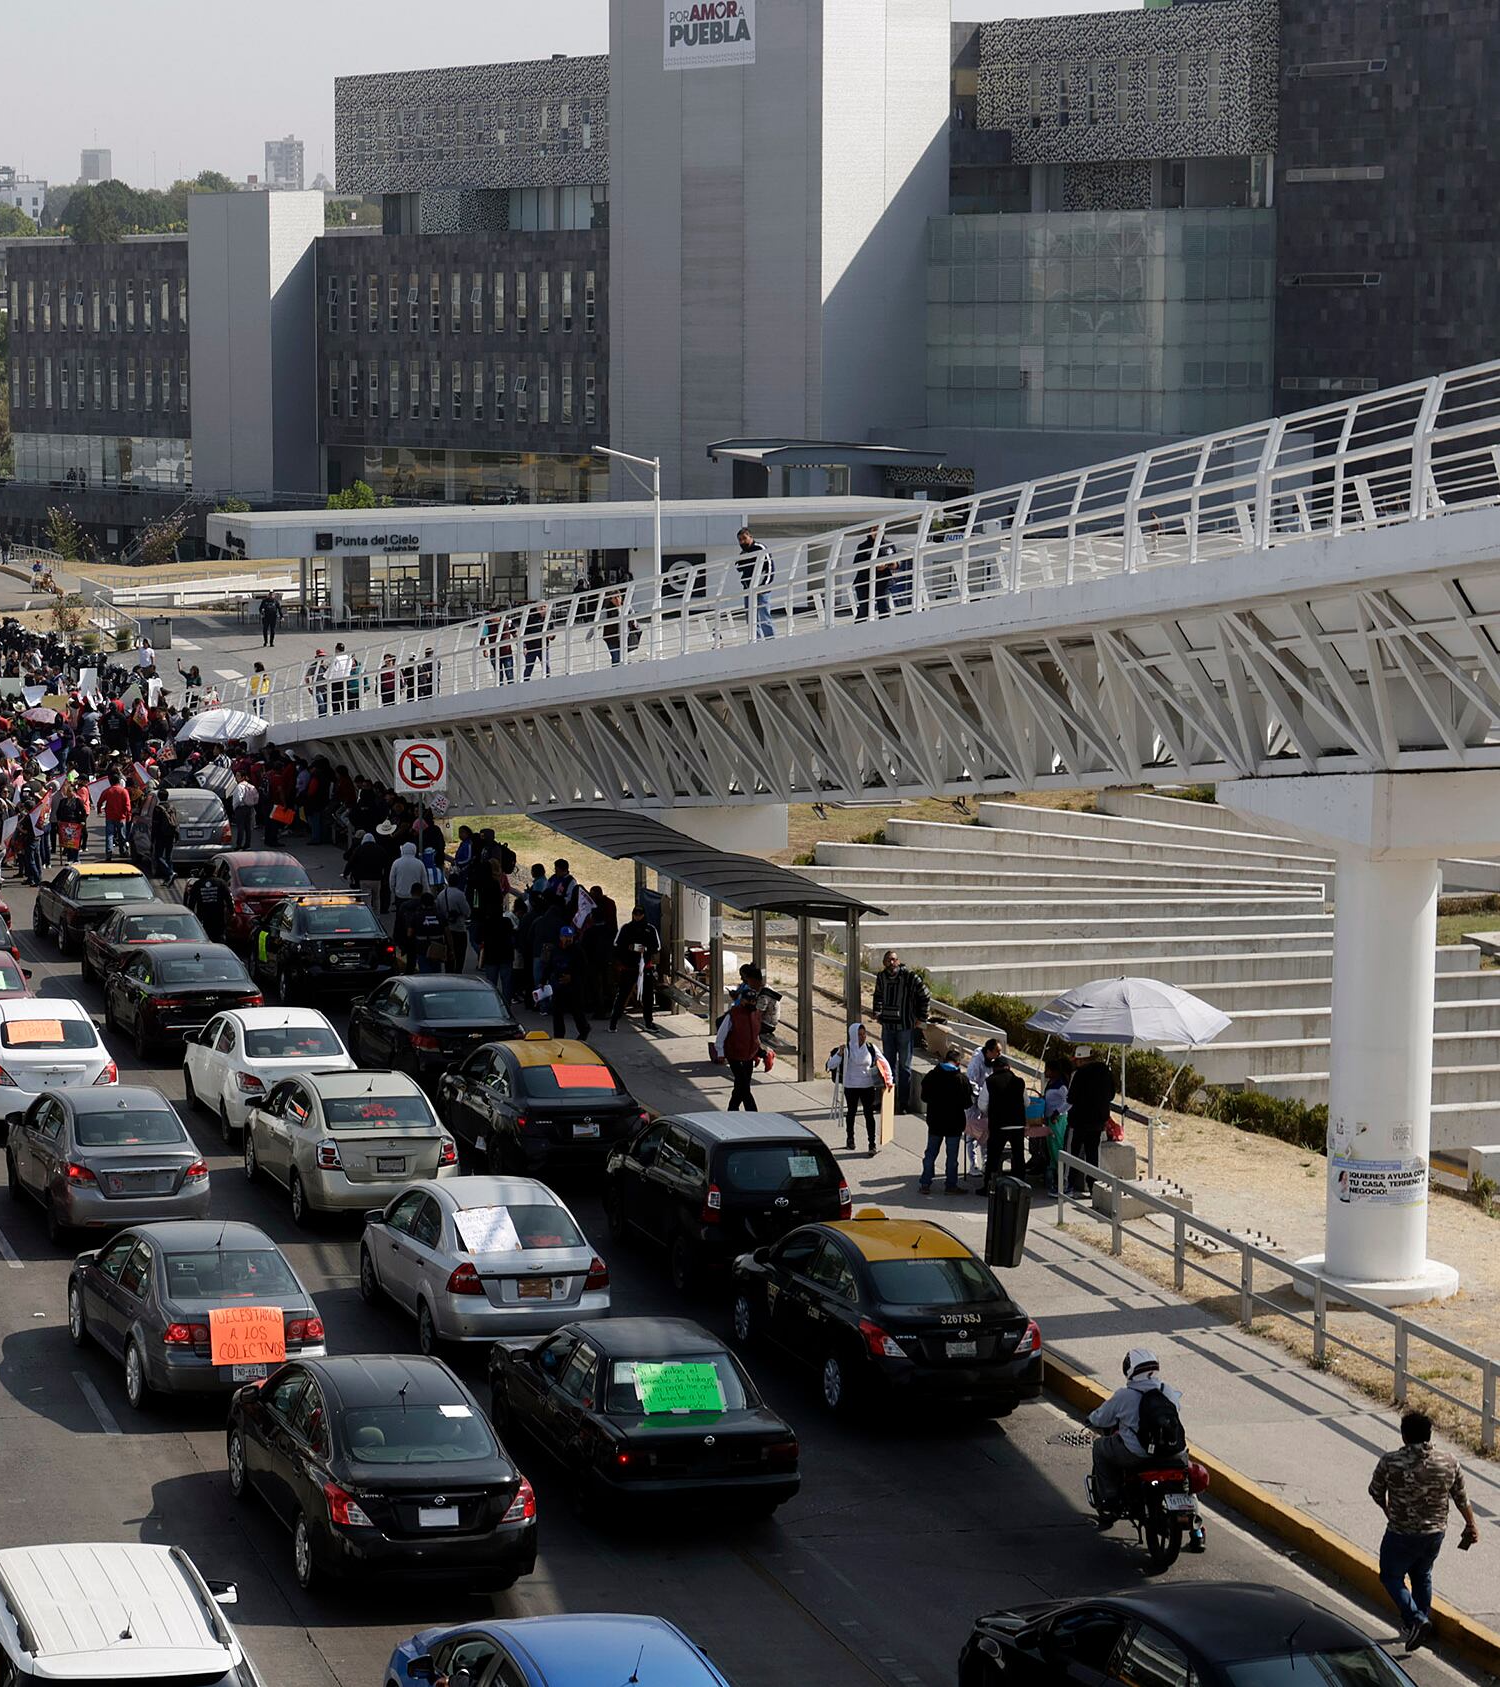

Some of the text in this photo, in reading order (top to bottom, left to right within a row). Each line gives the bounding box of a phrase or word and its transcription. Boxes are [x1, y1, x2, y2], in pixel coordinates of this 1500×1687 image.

[669, 11, 690, 23] POR
[689, 1, 738, 21] AMOR
[669, 19, 751, 48] PUEBLA
[335, 533, 419, 547] Punta del Cielo
[1387, 1172, 1413, 1180] AYUDA
[1389, 1178, 1420, 1187] TERRENO
[214, 1308, 282, 1324] NECESITAMOS
[940, 1313, 982, 1324] 3267SSJ
[230, 1325, 268, 1340] A LOS
[219, 1341, 285, 1361] COLECTIVOS
